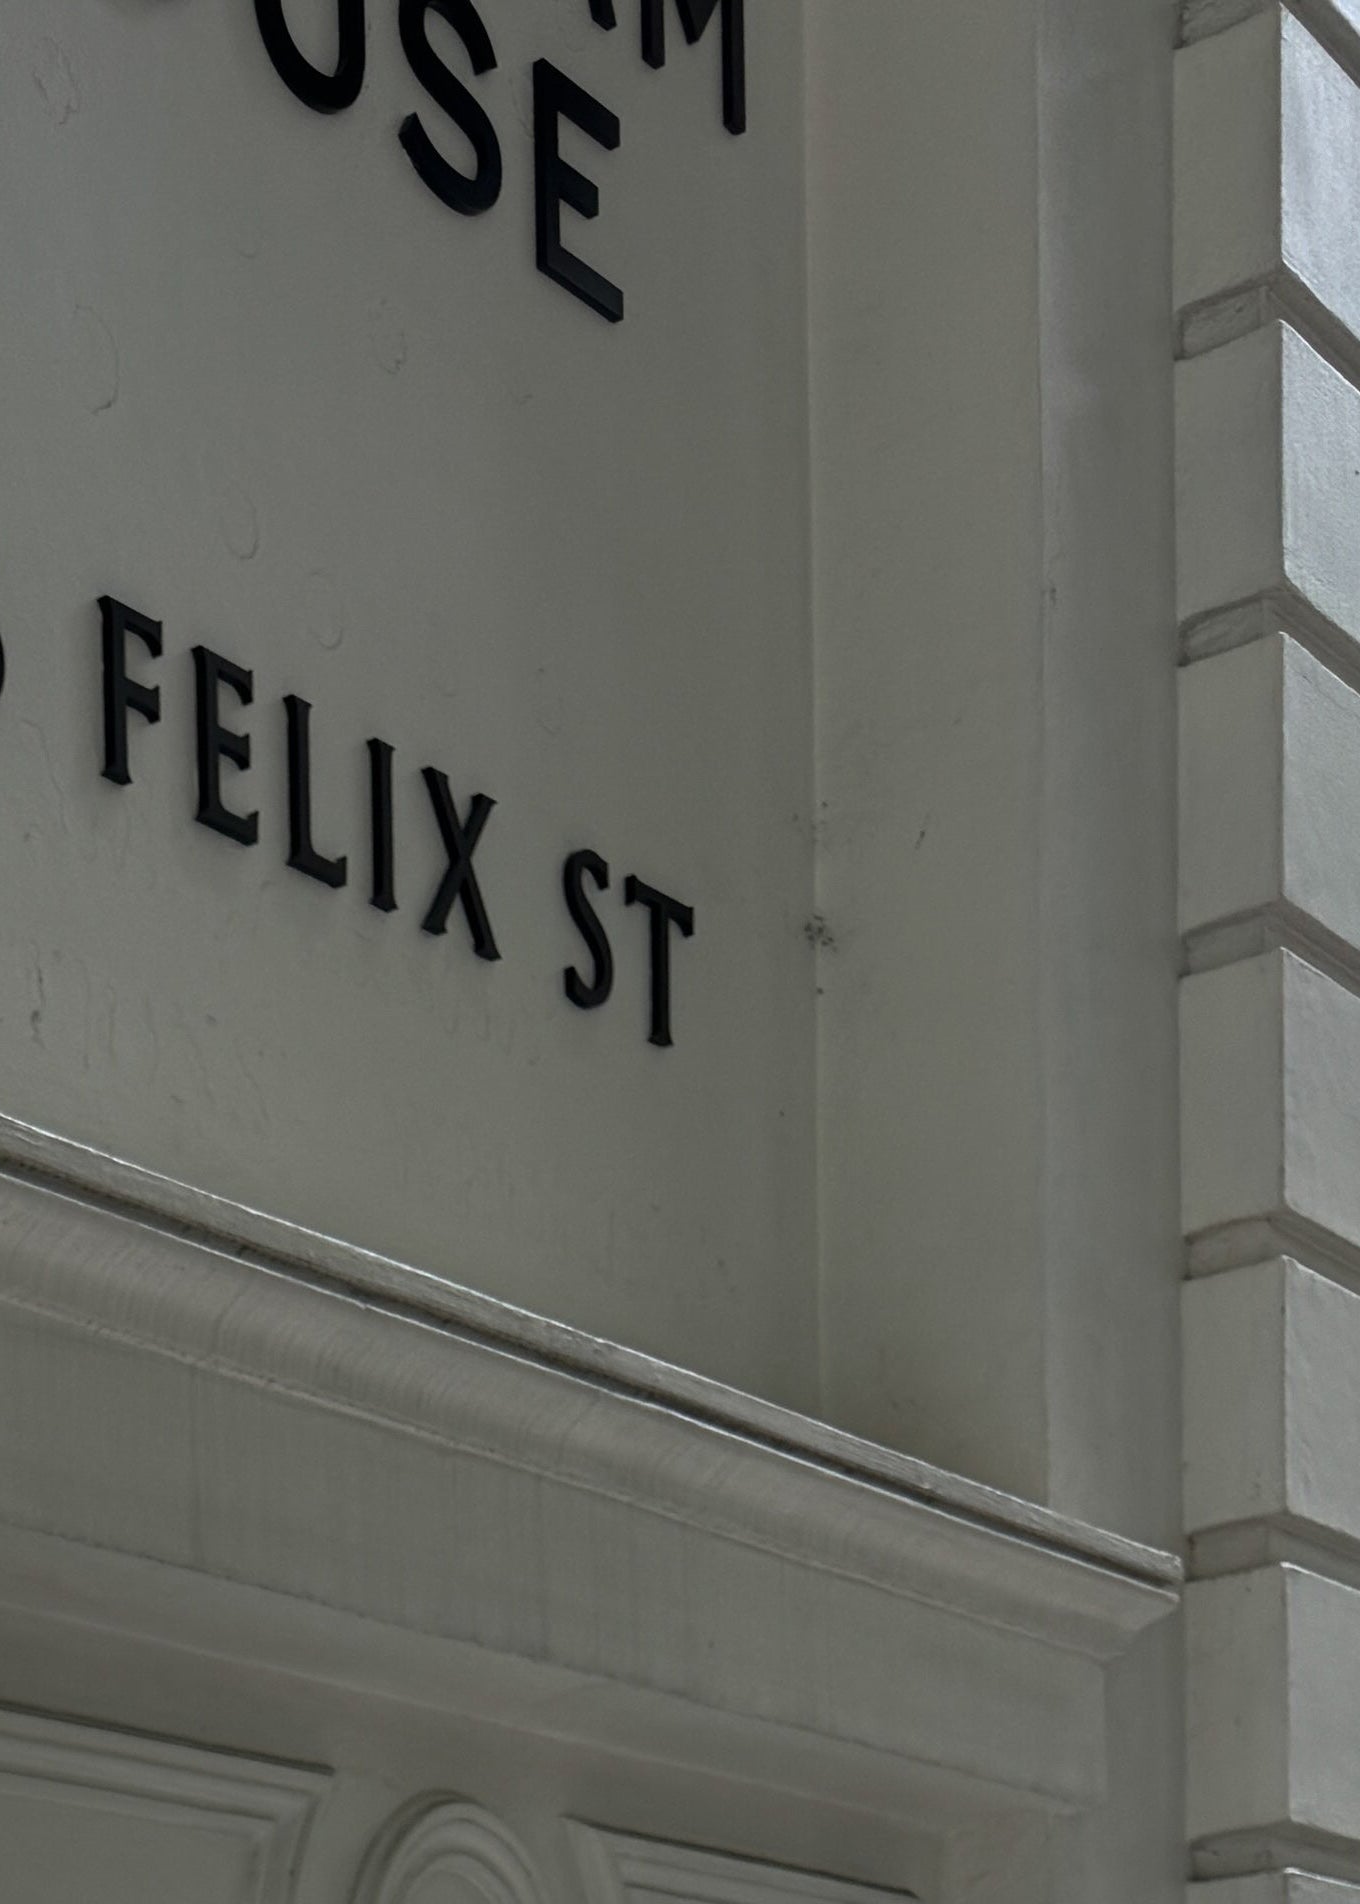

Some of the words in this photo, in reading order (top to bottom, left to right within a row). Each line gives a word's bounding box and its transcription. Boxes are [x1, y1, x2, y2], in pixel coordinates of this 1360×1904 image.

[125, 0, 623, 324] USE
[588, 0, 746, 135] M
[96, 594, 502, 962] FELIX
[562, 848, 695, 1048] ST
